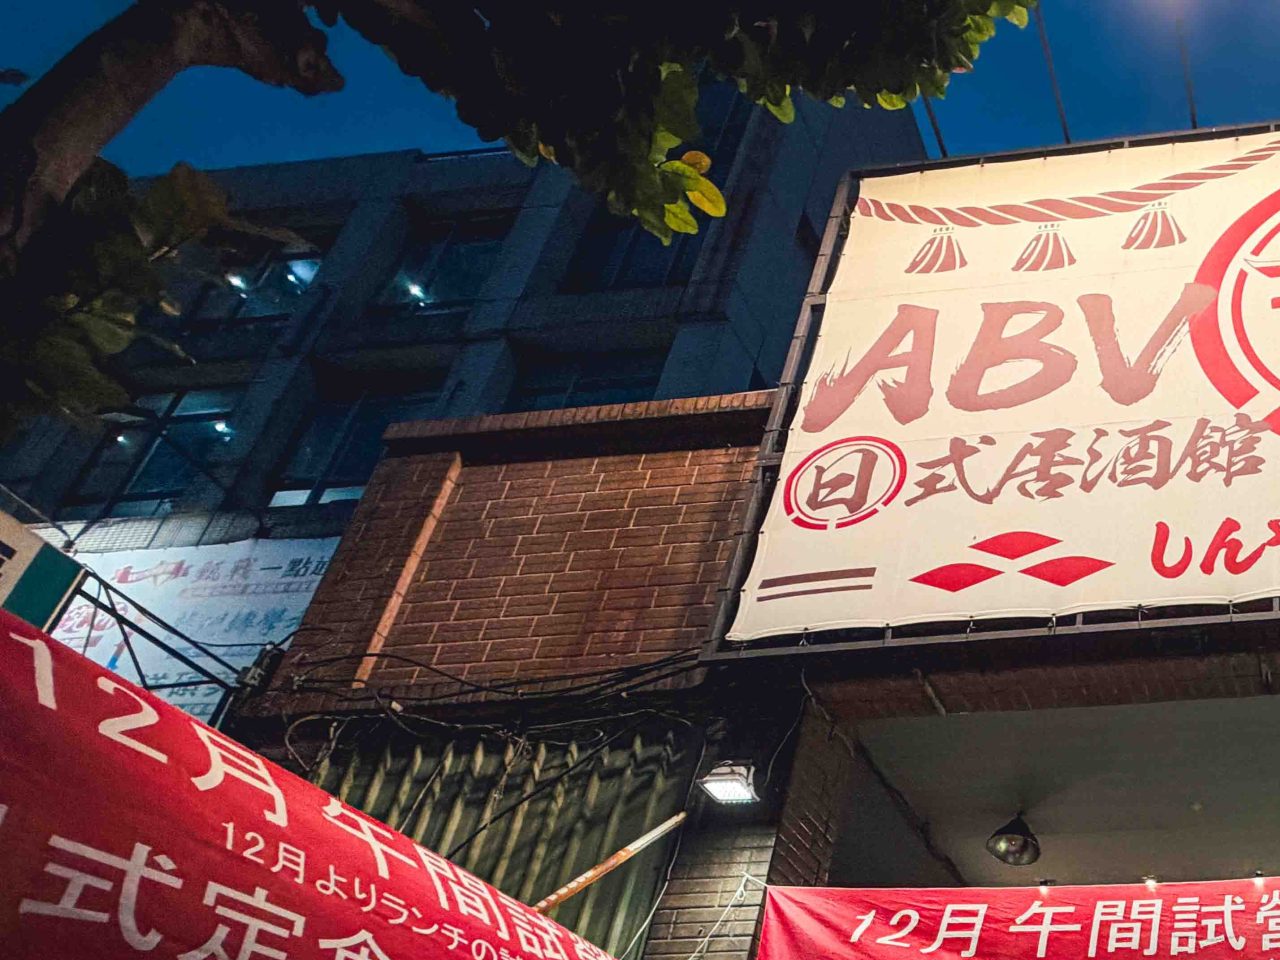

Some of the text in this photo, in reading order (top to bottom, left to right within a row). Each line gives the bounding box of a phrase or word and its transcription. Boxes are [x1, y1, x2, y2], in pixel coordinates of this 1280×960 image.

[801, 283, 1218, 433] ABV
[804, 411, 1275, 514] 日式居酒館
